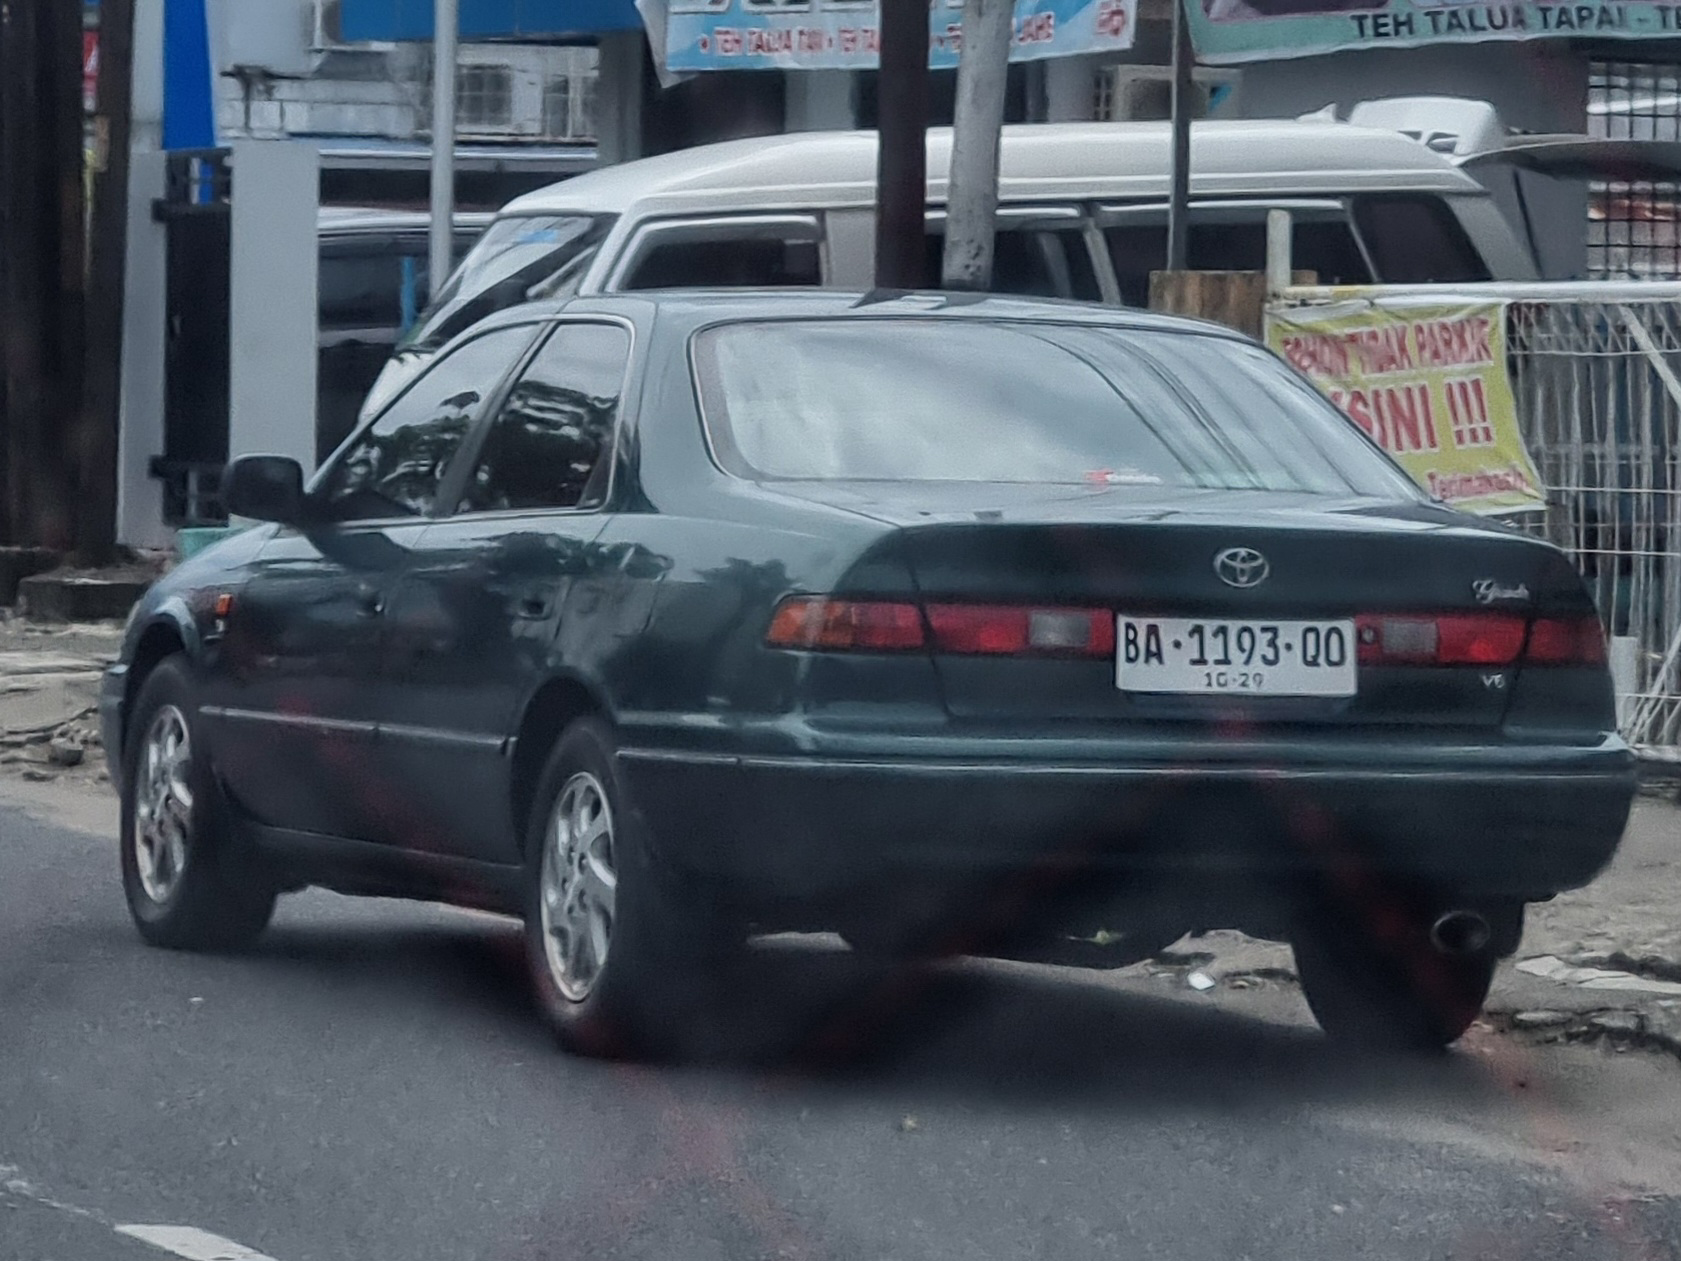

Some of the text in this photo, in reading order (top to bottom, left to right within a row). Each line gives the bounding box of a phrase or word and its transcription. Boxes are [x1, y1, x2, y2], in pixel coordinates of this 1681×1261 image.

[1351, 13, 1414, 38] TEH
[1424, 5, 1525, 34] TALUA
[1537, 5, 1627, 30] TAPAI
[1445, 378, 1492, 445] !!!
